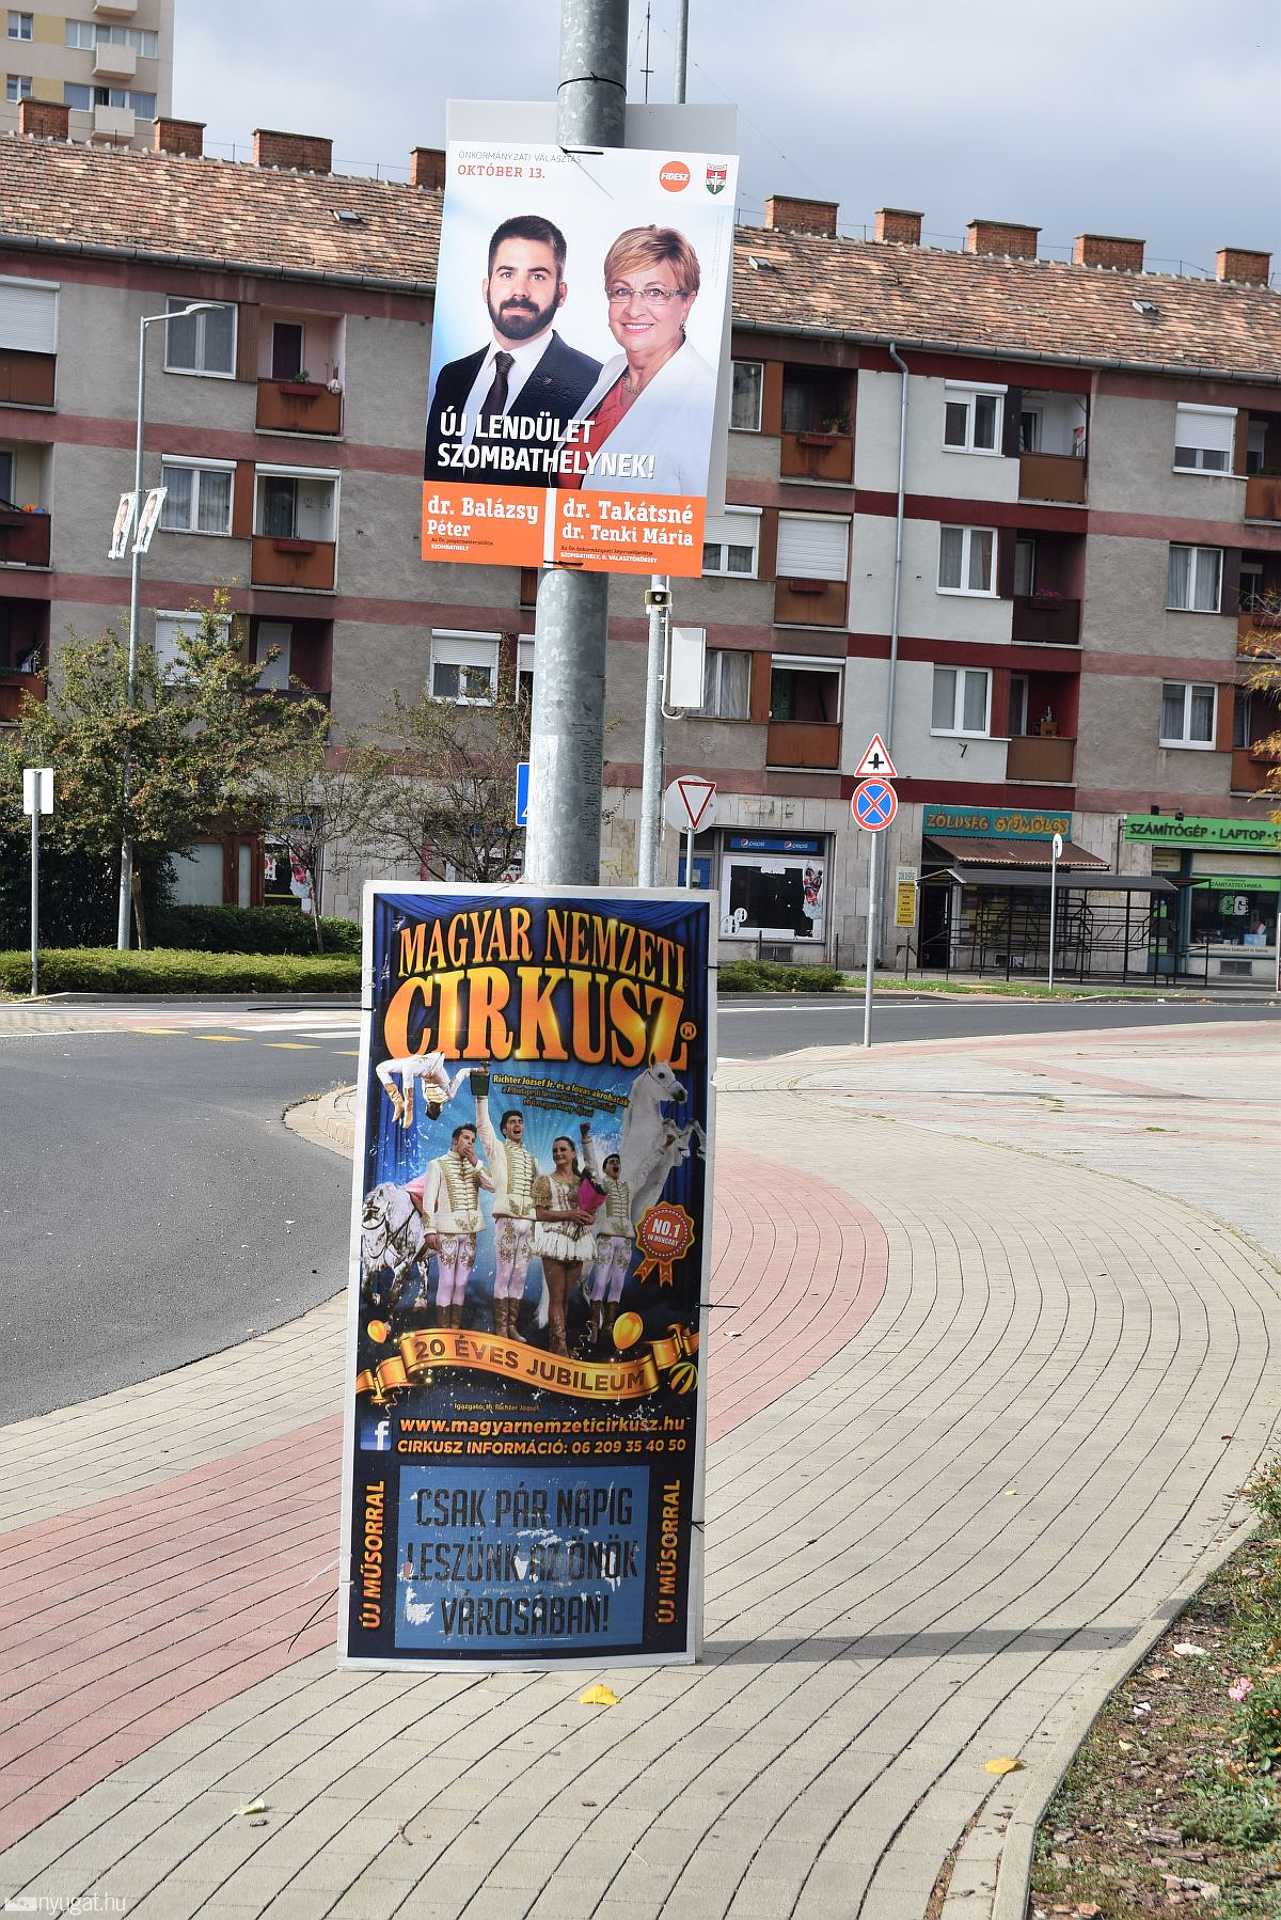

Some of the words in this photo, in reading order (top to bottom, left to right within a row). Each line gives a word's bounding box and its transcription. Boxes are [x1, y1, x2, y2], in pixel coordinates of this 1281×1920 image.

[457, 163, 523, 178] OKTÓBER
[528, 167, 546, 179] 13.
[440, 405, 466, 438] ÚJ
[475, 411, 596, 444] LENDÜLET
[437, 443, 656, 479] SZOMBATHELYNEK!
[428, 495, 455, 515] dr.
[461, 496, 539, 525] Balázsy
[562, 497, 591, 518] dr.
[598, 500, 694, 525] Takátsné
[427, 519, 471, 537] Péter
[562, 522, 585, 539] dr.
[590, 524, 638, 543] Tenki
[642, 527, 694, 546] Mária
[927, 811, 989, 831] ZÖLDSÉG
[1130, 820, 1208, 838] SZÁMÍTÓGÉP
[1219, 827, 1267, 841] LAPTOP
[398, 907, 533, 977] MAGYAR
[544, 909, 685, 993] NEMZETI
[652, 1218, 681, 1238] NO.1
[414, 1338, 446, 1360] 20
[454, 1334, 520, 1369] ÉVES
[525, 1358, 645, 1391] JUBILEUM
[400, 1416, 685, 1436] www.magyarnemzeticirkusz.hu
[397, 1439, 464, 1454] CIRKUSZ
[466, 1438, 568, 1454] INFORMÁCIÓ:
[571, 1441, 592, 1454] 06
[593, 1440, 623, 1454] 209
[625, 1440, 642, 1453] 35
[645, 1439, 664, 1452] 40
[668, 1438, 686, 1451] 50
[415, 1487, 487, 1528] CSAK
[495, 1481, 550, 1528] PÁR
[556, 1487, 633, 1528] NAPIG
[360, 1480, 385, 1599] MŰSORRAL
[656, 1479, 681, 1594] MŰSORRAL
[406, 1536, 520, 1582] LESZÜNK
[568, 1534, 639, 1580] ÖNÖK
[358, 1602, 381, 1629] ÚJ
[441, 1589, 609, 1636] VÁROSÁBAN!
[655, 1599, 677, 1624] ÚJ
